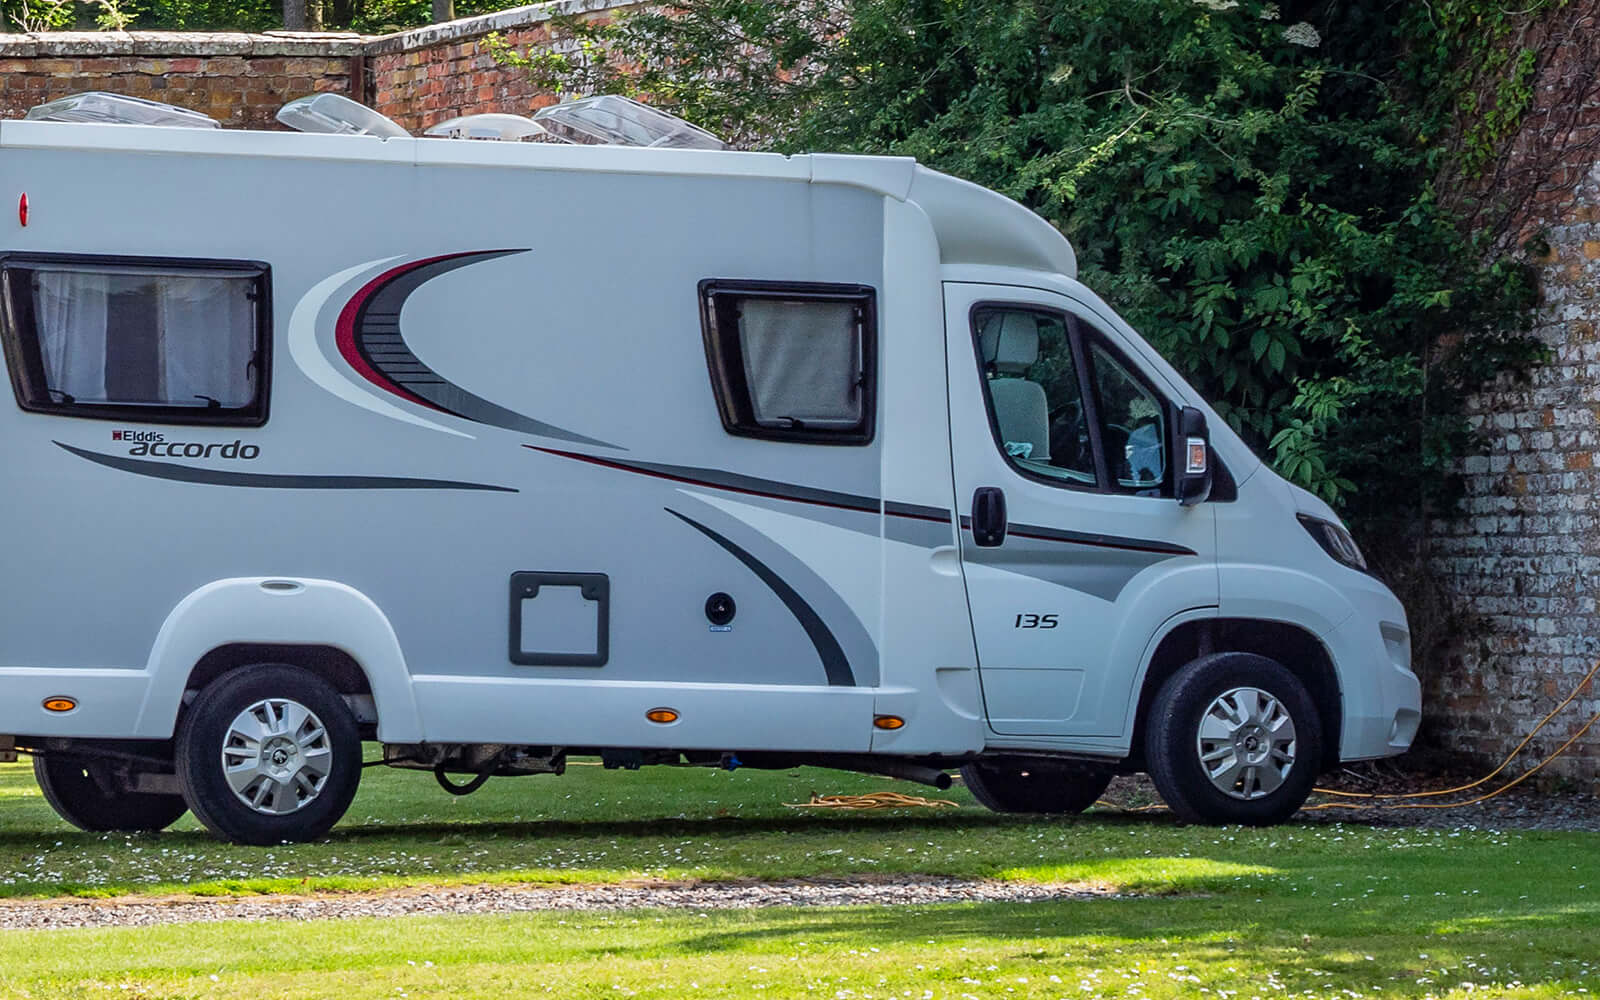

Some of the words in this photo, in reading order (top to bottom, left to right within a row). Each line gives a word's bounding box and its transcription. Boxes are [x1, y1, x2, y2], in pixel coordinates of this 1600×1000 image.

[123, 430, 164, 442] Elddis
[129, 440, 260, 459] accordo
[1015, 613, 1060, 629] 135
